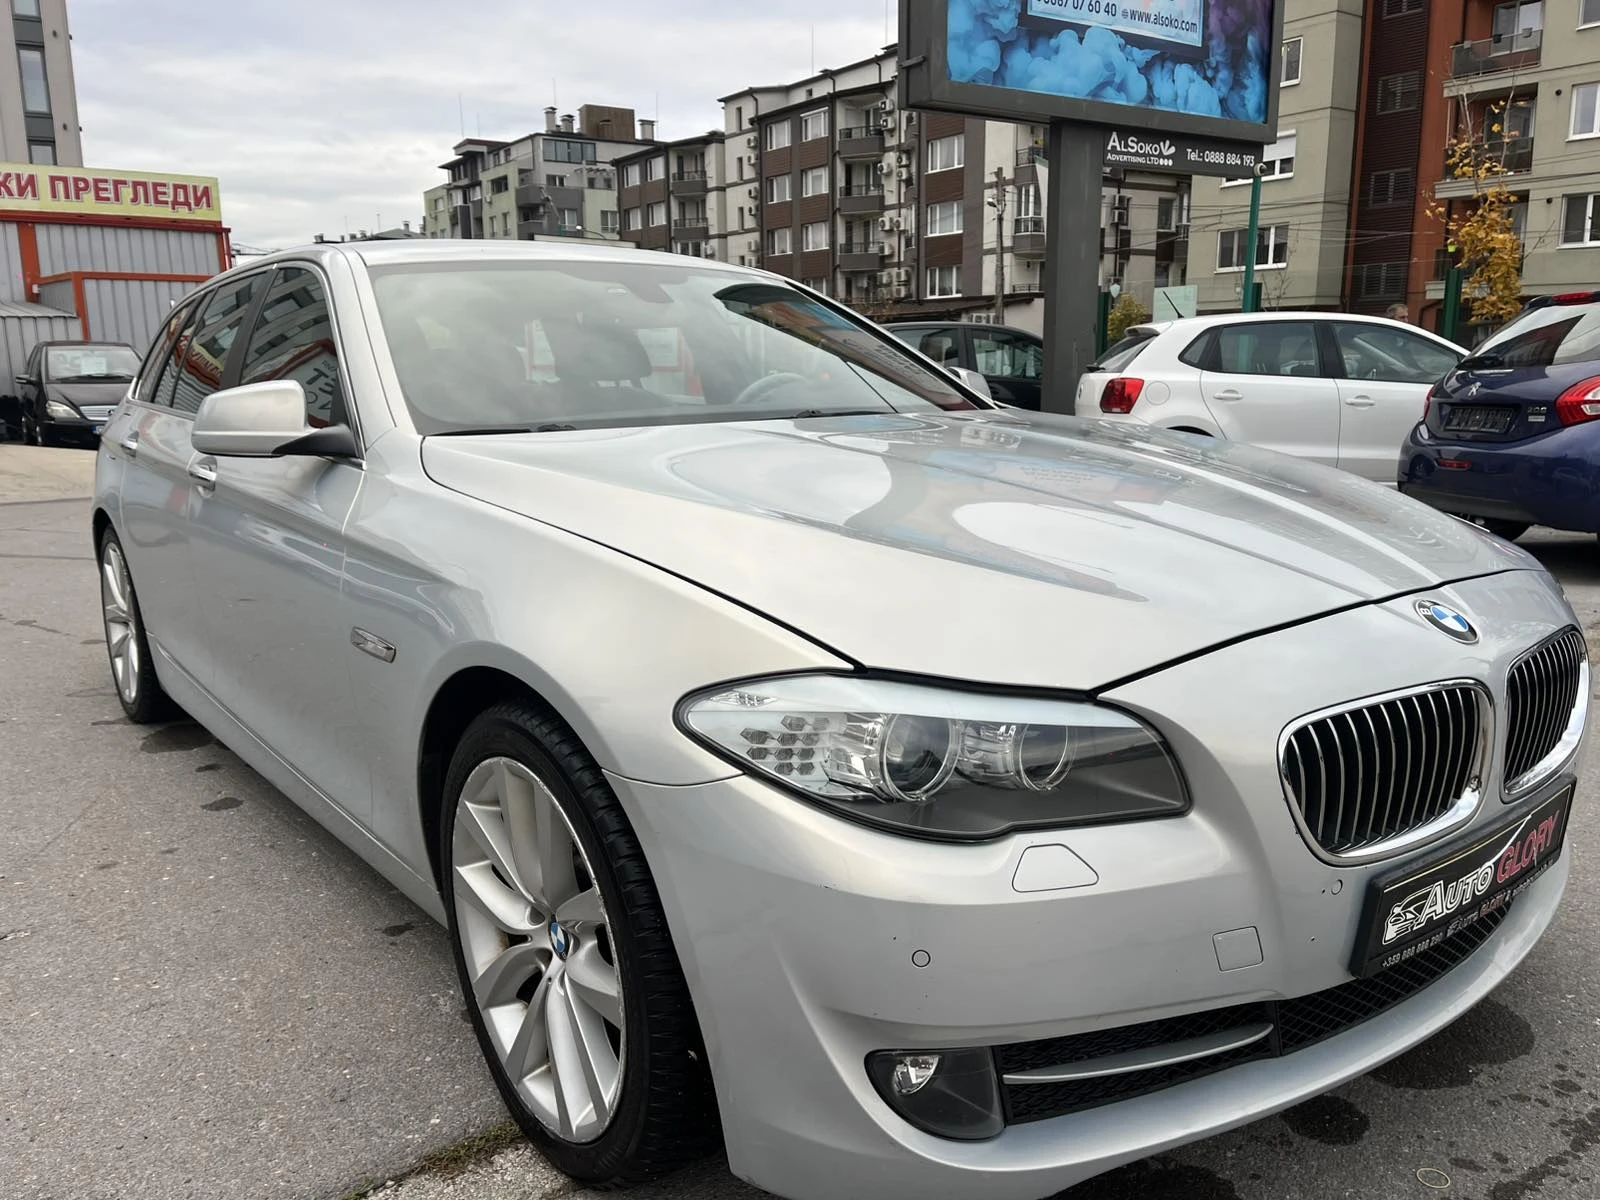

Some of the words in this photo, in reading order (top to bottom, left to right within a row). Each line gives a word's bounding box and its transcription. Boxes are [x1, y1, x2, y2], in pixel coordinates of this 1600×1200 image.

[1087, 0, 1101, 14] 60
[1104, 2, 1117, 17] 40
[1129, 8, 1198, 33] www.alsoko.com
[1106, 153, 1146, 163] ADVERTISING
[1146, 156, 1160, 165] LTD
[1204, 150, 1224, 164] 0888
[1225, 153, 1241, 166] 884
[1242, 154, 1255, 167] 193
[48, 174, 213, 212] ПРЕГЛЕДИ
[1497, 809, 1560, 884] GLORY
